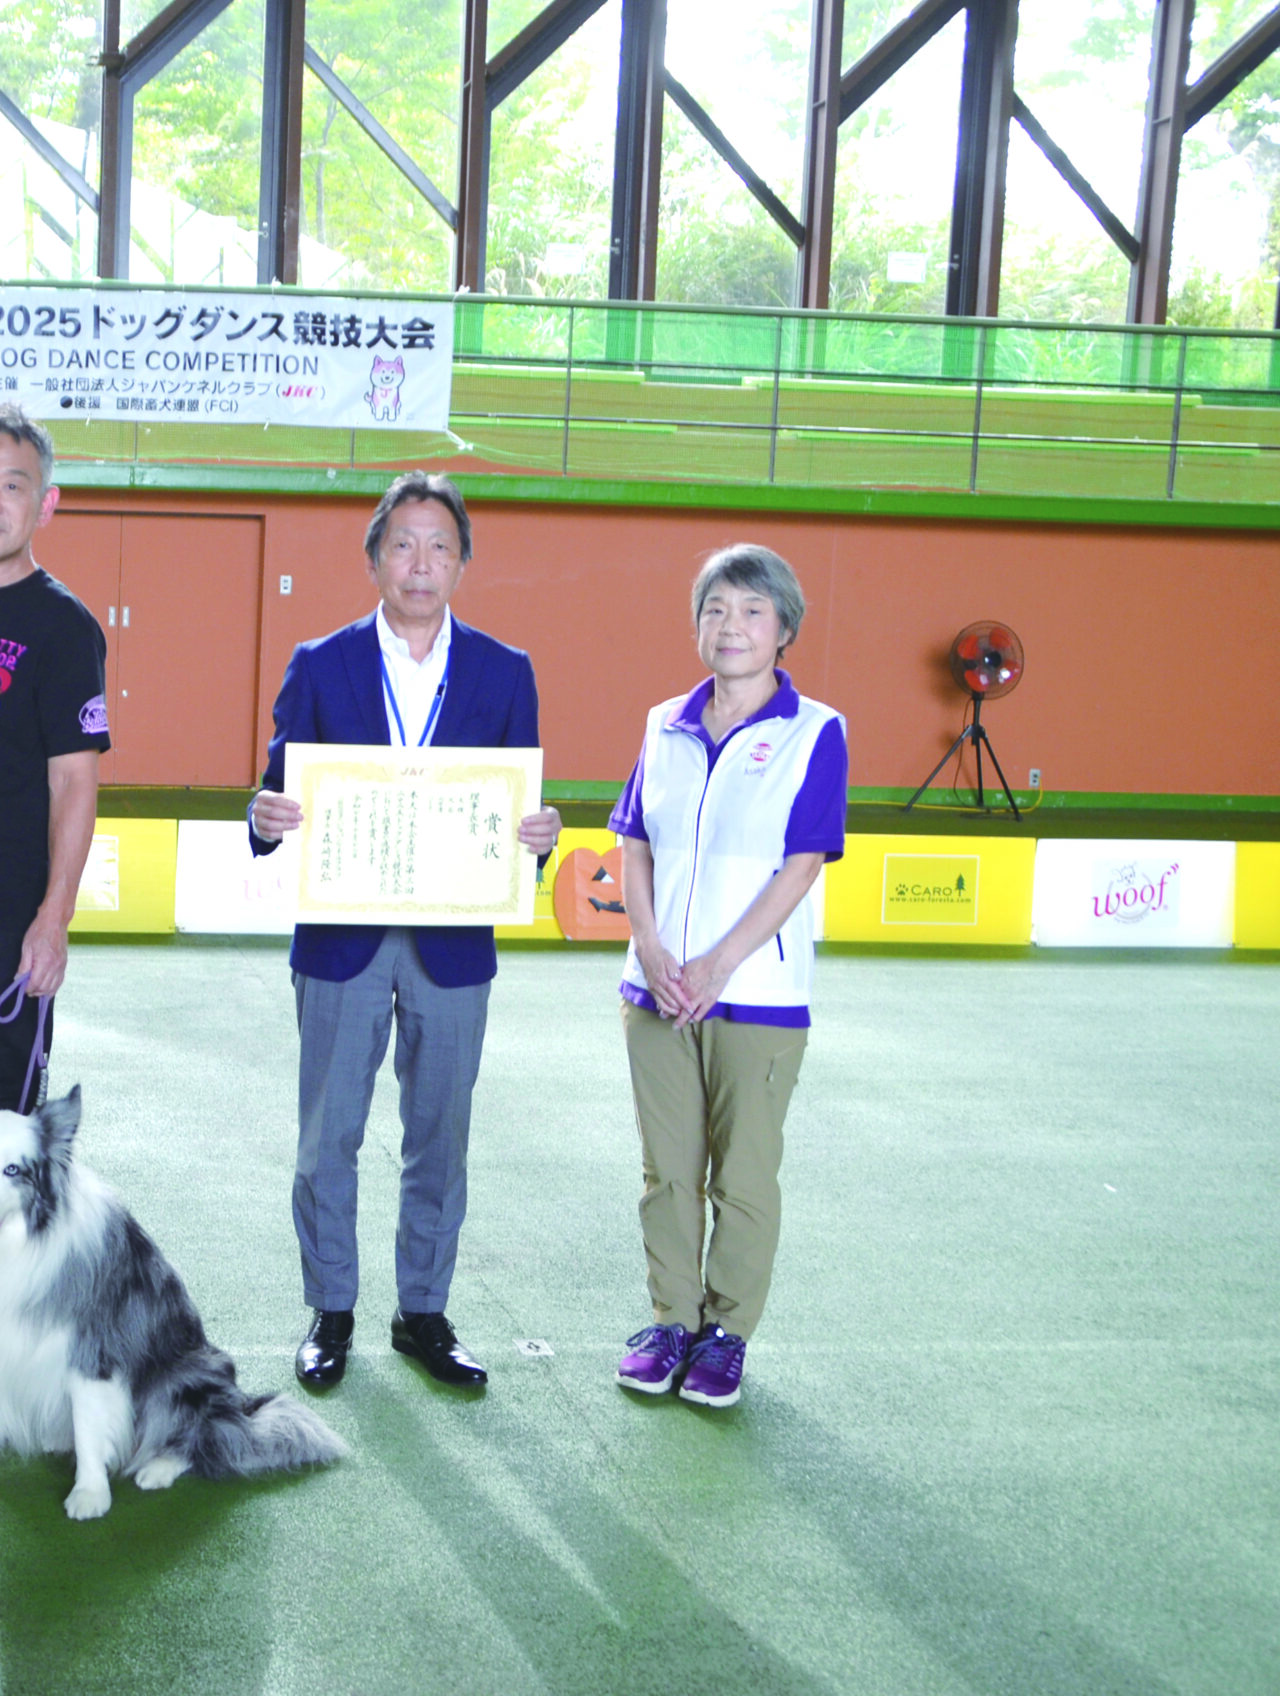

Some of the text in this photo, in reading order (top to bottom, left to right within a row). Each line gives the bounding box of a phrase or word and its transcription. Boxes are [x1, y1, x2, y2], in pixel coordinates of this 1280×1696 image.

[47, 348, 136, 370] DANCE
[145, 351, 319, 376] COMPETITION
[482, 812, 502, 860] 賞状
[911, 884, 953, 897] CARO
